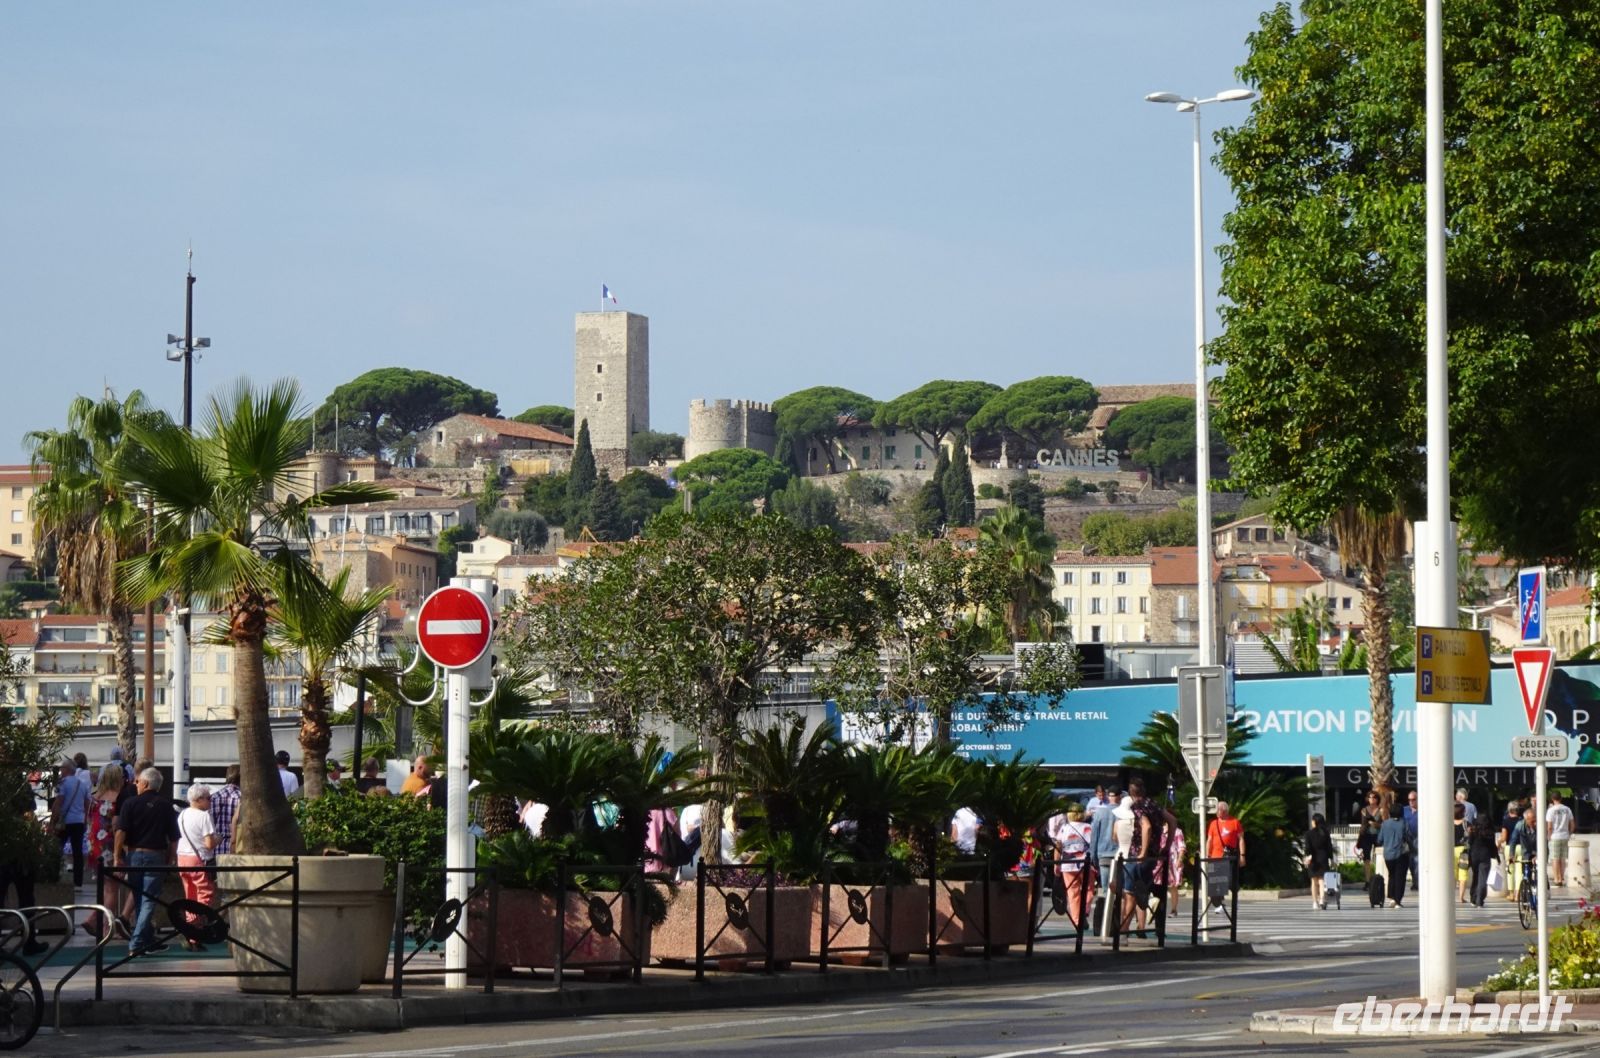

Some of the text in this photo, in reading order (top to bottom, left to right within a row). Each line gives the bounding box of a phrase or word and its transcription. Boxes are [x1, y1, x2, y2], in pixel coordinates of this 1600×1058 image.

[1036, 448, 1119, 466] CANNES
[1434, 551, 1440, 566] 6
[1024, 712, 1031, 721] &
[1034, 712, 1071, 721] TRAVEL
[1075, 711, 1109, 720] RETAIL
[1550, 740, 1560, 748] LE
[1520, 749, 1560, 757] PASSAGE
